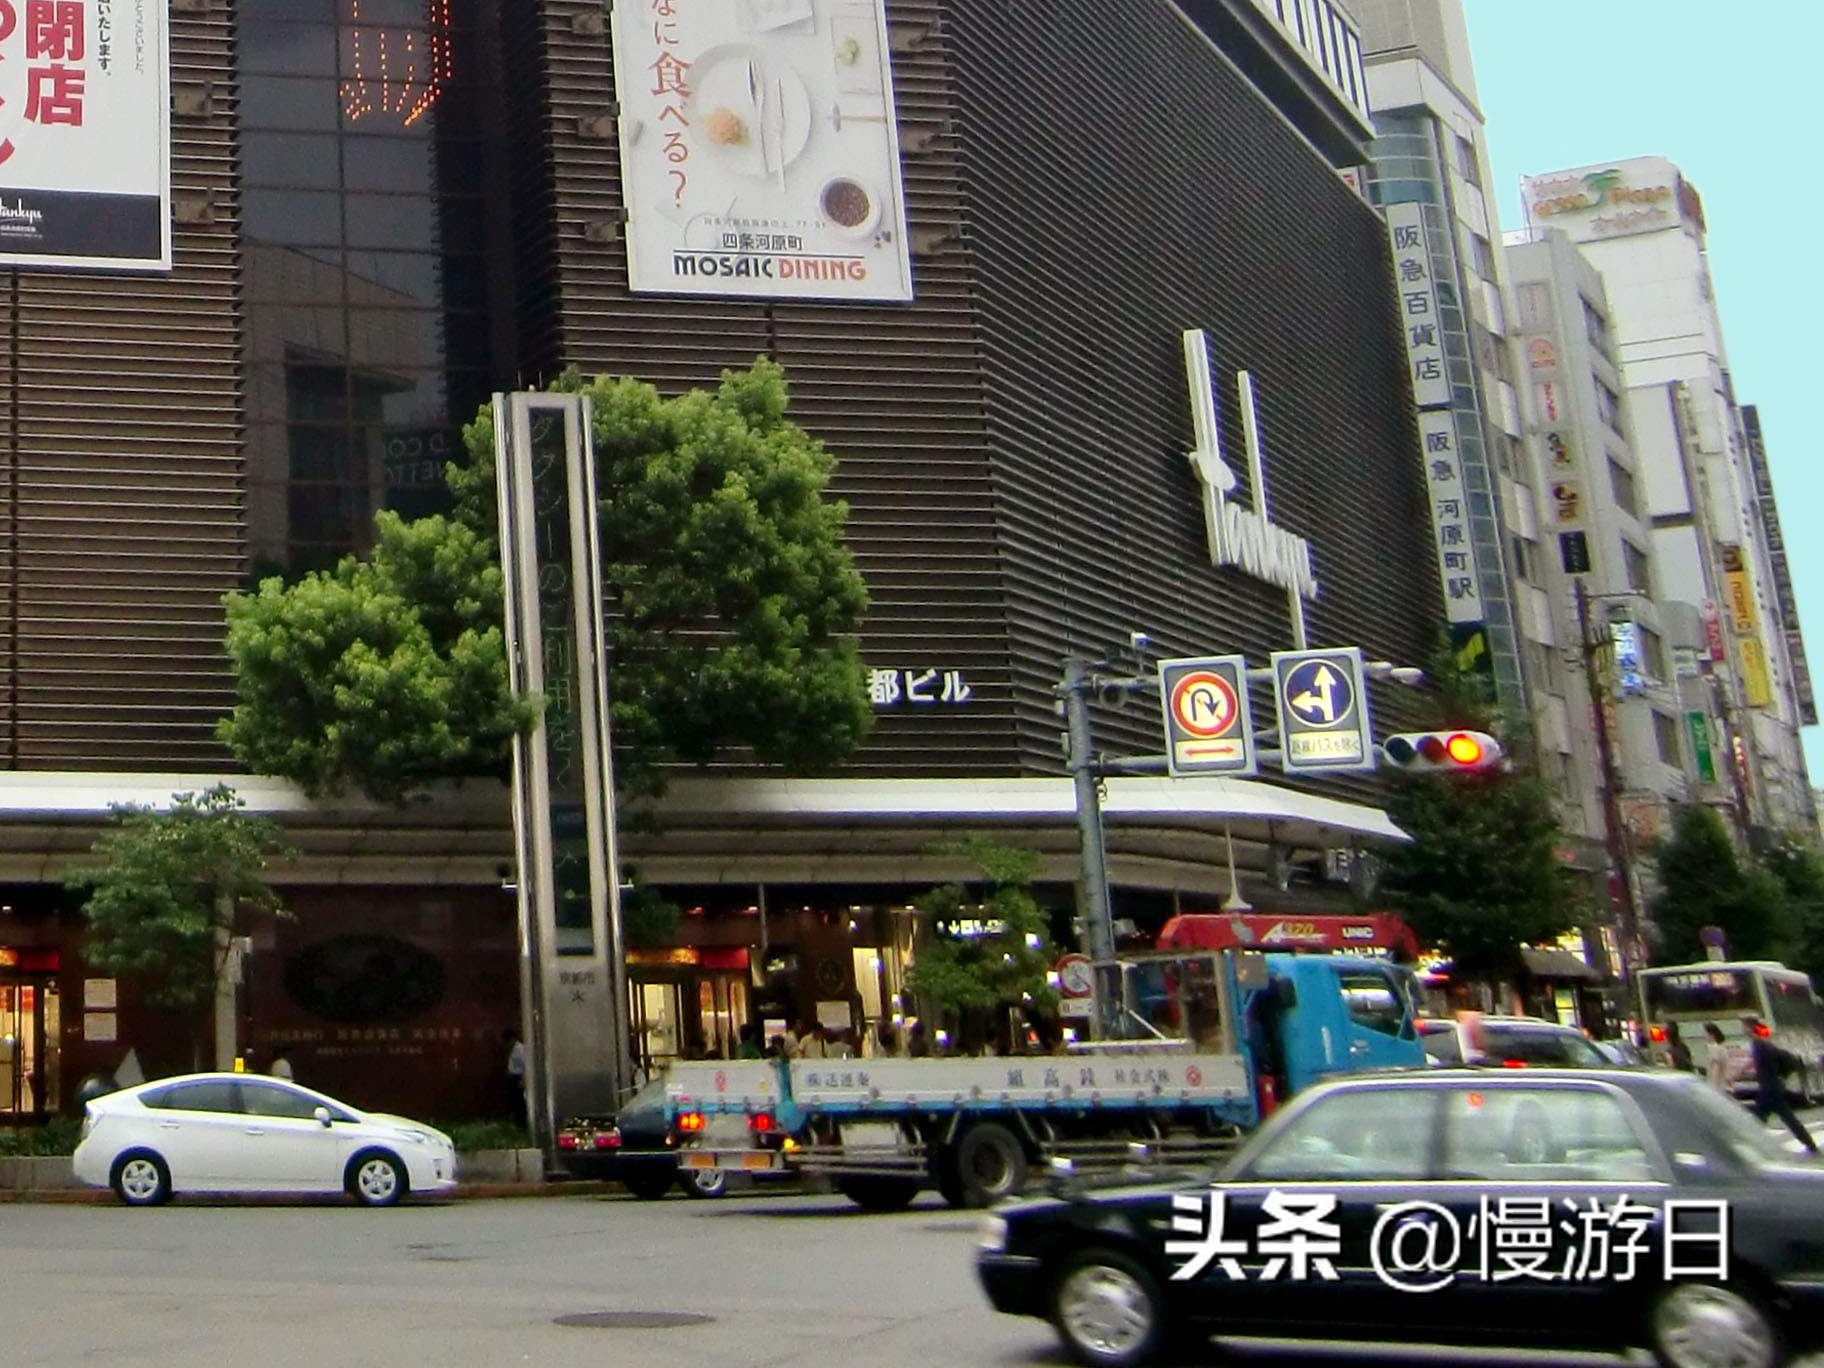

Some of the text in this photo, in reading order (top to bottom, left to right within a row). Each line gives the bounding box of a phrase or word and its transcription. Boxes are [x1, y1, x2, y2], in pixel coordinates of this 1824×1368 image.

[723, 233, 803, 251] 四条河原町
[673, 254, 867, 281] MOSAIC DINING
[1393, 226, 1442, 383] 阪急百貨店
[1426, 432, 1476, 600] 阪急 河原町駅
[1342, 927, 1374, 938] UNIC
